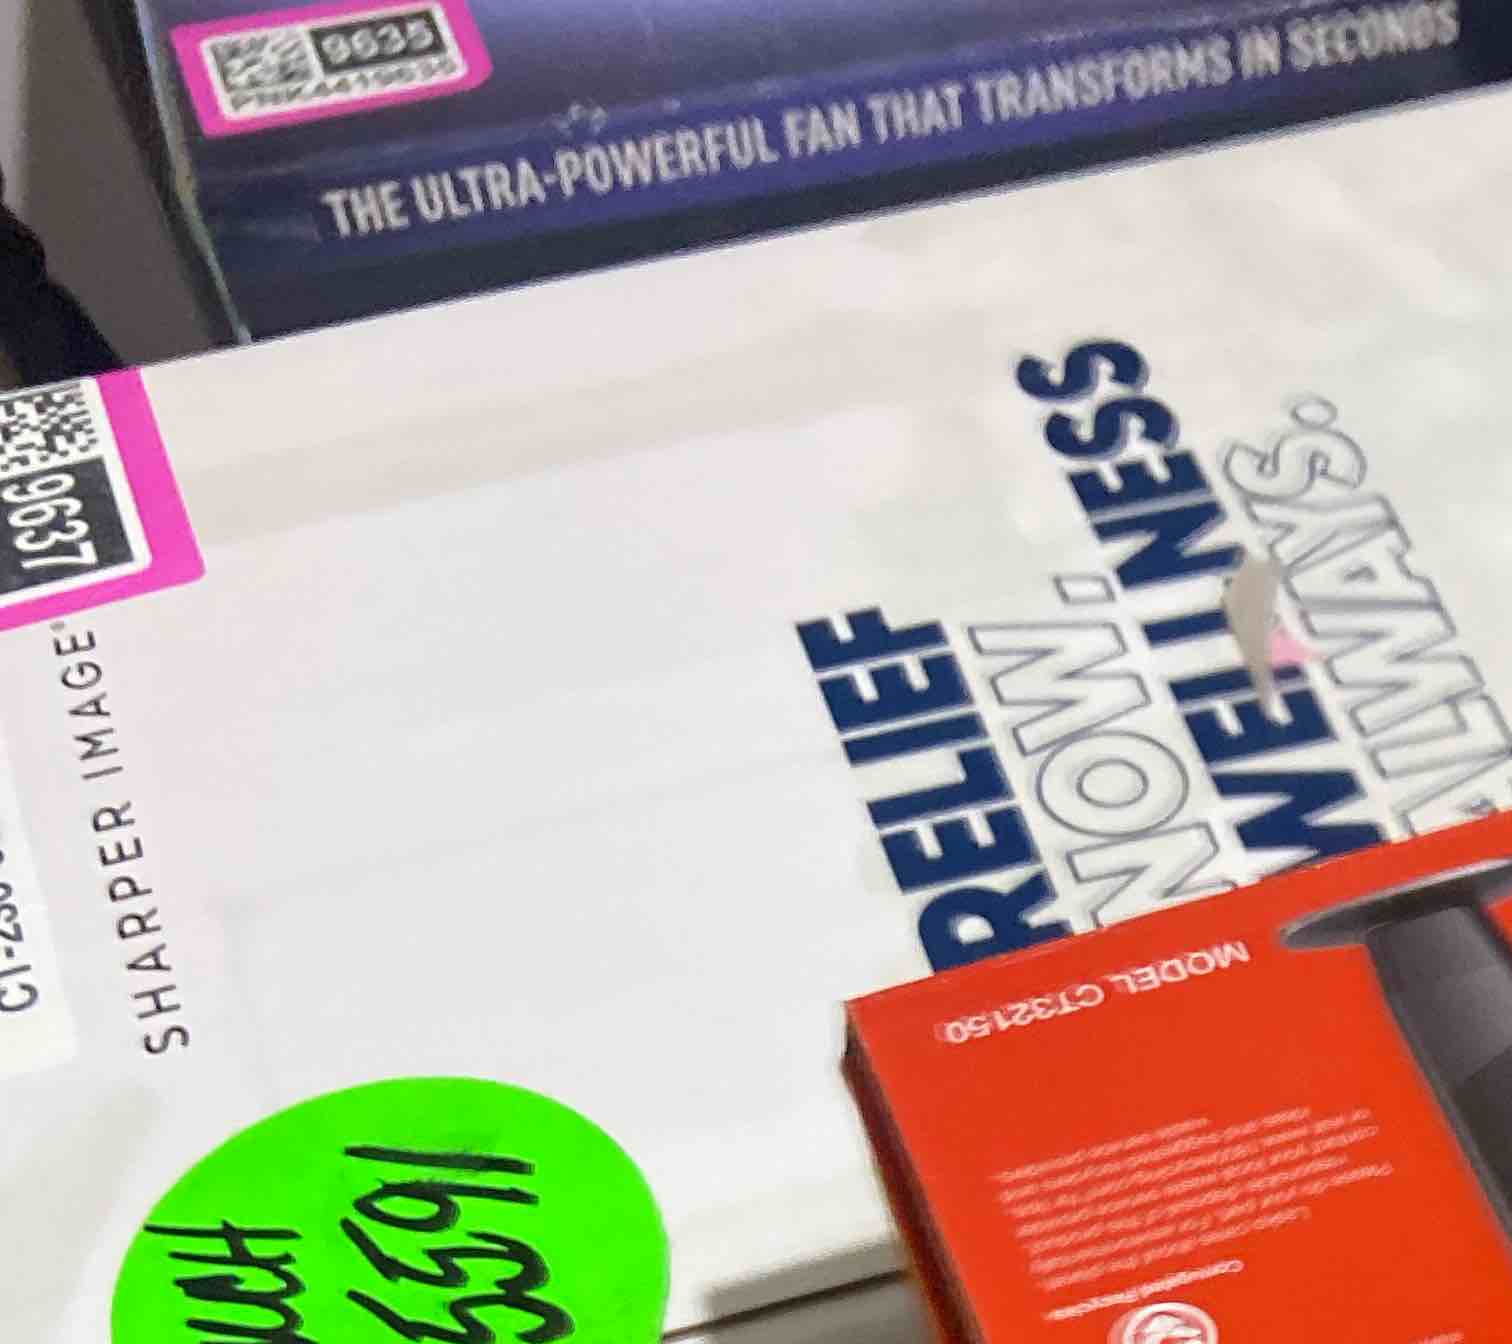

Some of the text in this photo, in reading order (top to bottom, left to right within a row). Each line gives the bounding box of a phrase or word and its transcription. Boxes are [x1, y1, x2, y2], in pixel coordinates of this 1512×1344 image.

[322, 1, 1462, 240] THE ULTRA-POWERFUL FAN THAT TRANSFORMS IN SECONDS
[2, 471, 98, 569] 9637
[52, 622, 191, 1057] SHARPER IMAGE
[795, 605, 1076, 974] RELIEF
[934, 940, 1252, 1044] MODEL CT32150
